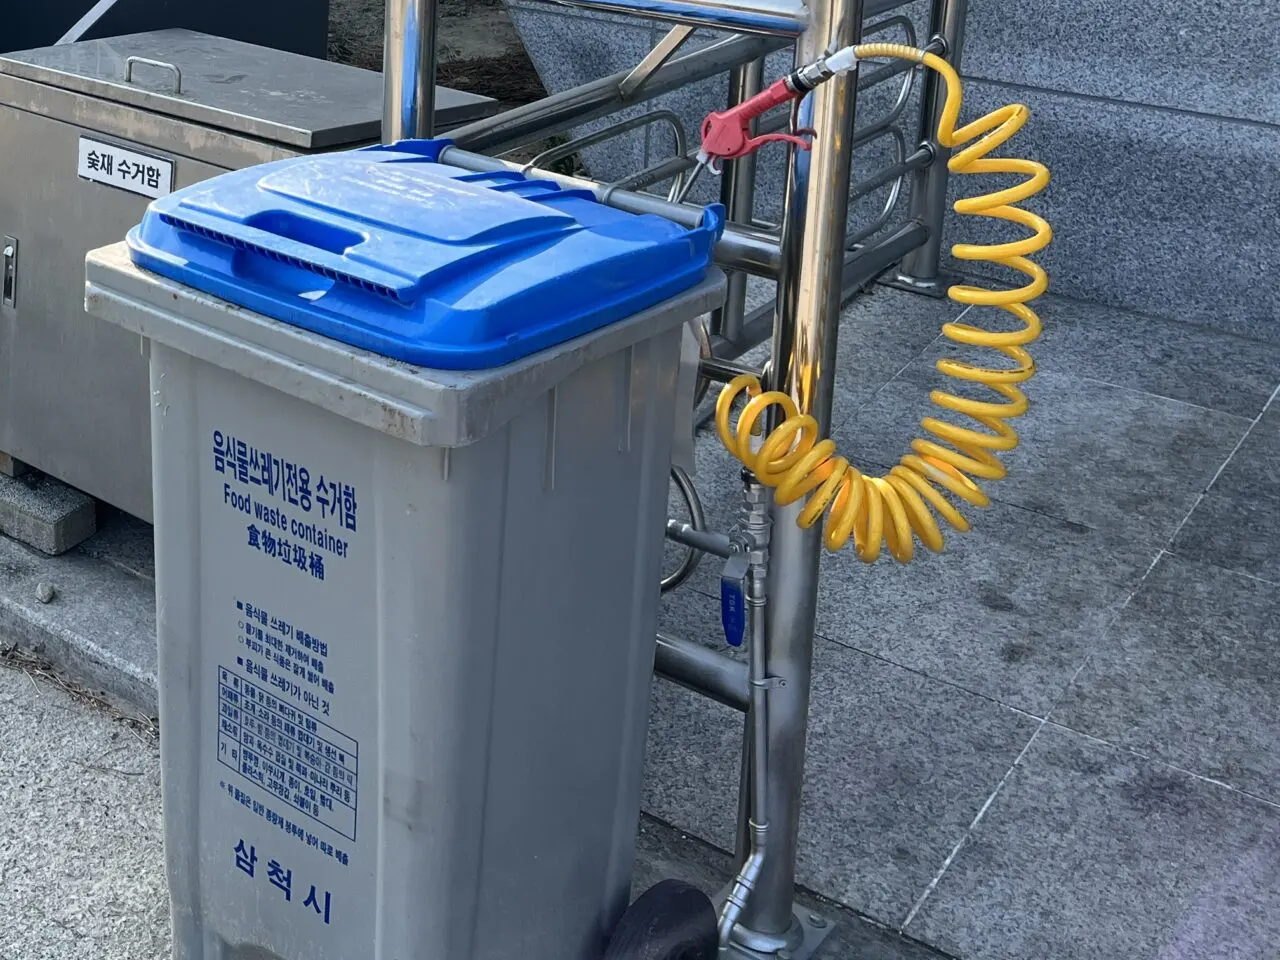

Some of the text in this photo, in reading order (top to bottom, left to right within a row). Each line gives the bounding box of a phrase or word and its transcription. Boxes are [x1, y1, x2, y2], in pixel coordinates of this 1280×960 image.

[87, 150, 161, 189] 숯재 수거함
[213, 430, 357, 532] 음식물쓰레기전용 수거함
[224, 483, 348, 559] Food waste container
[247, 523, 325, 581] 食物垃圾桶
[245, 602, 269, 627] 음식물
[270, 616, 295, 641] 쓰레기
[246, 657, 329, 716] 음식물 쓰레기가 아닌 것
